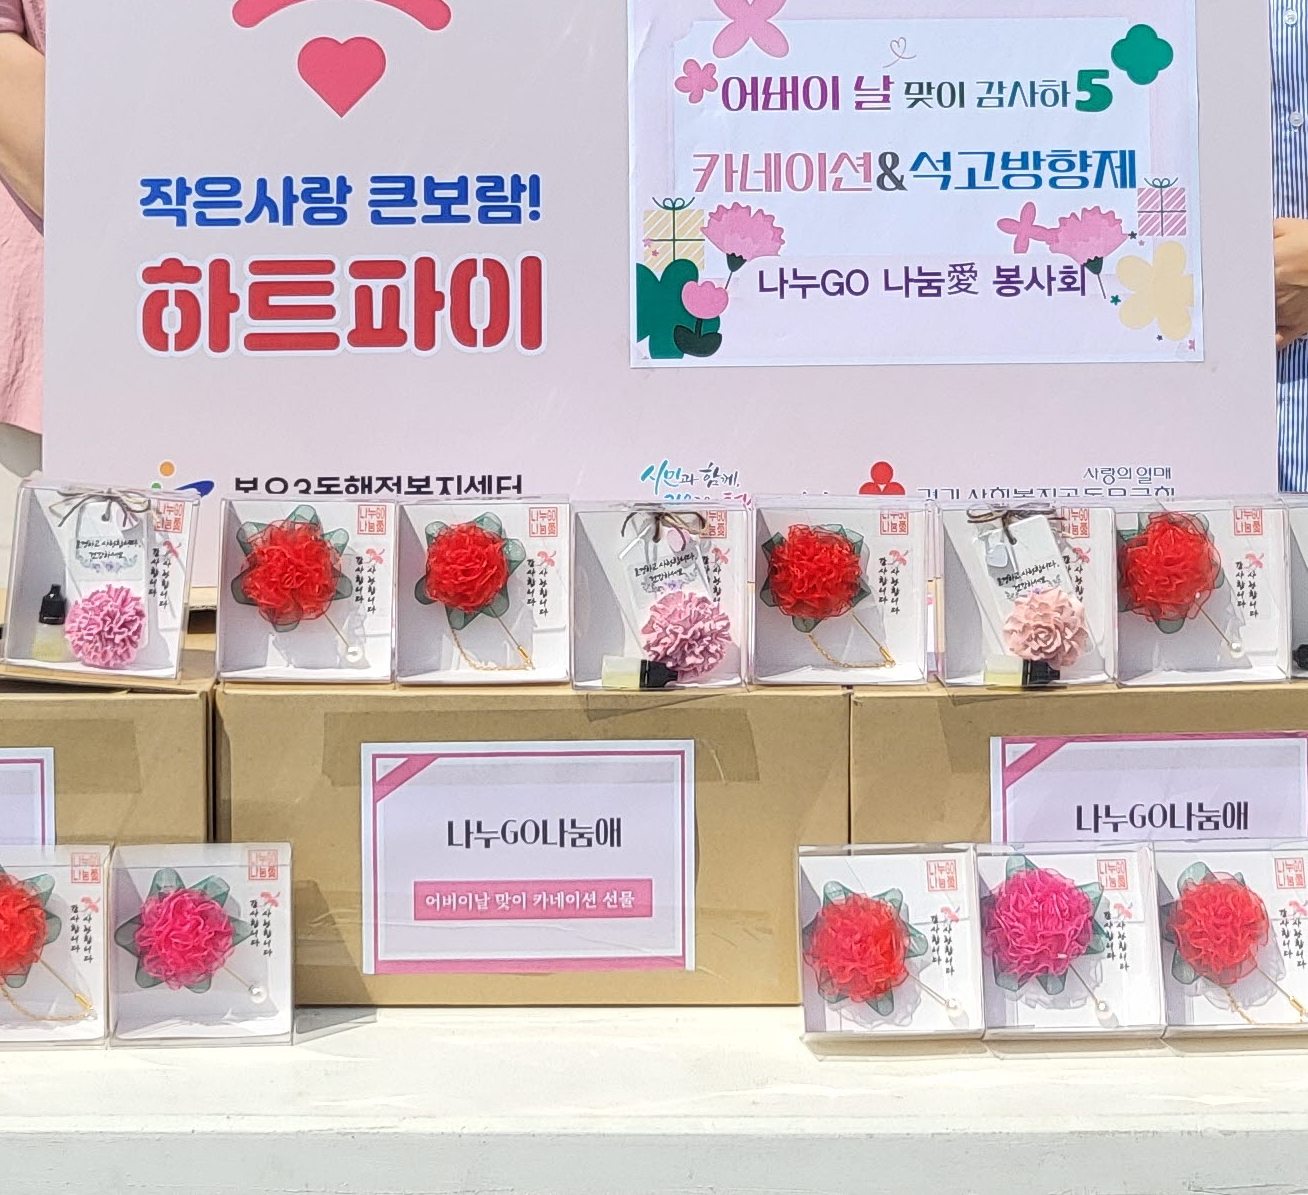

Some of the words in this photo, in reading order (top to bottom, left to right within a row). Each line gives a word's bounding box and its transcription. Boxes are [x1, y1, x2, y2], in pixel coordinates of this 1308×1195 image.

[721, 75, 840, 112] 어버이
[854, 74, 895, 111] 날
[904, 80, 965, 109] 맞이
[692, 150, 1137, 193] 카네이션&석고방향제
[138, 175, 353, 228] 작은사랑
[366, 174, 543, 226] 큰보람!
[758, 264, 869, 301] 나누GO
[992, 261, 1088, 300] 봉사회
[140, 253, 546, 357] 하트파이
[1083, 466, 1132, 485] 사랑의
[447, 817, 622, 849] 나누GO나눔애
[1076, 801, 1249, 833] 나누GO나눔애
[425, 892, 490, 911] 어버이날
[495, 891, 527, 910] 맞이
[532, 890, 597, 909] 카네이션
[602, 890, 635, 909] 선물
